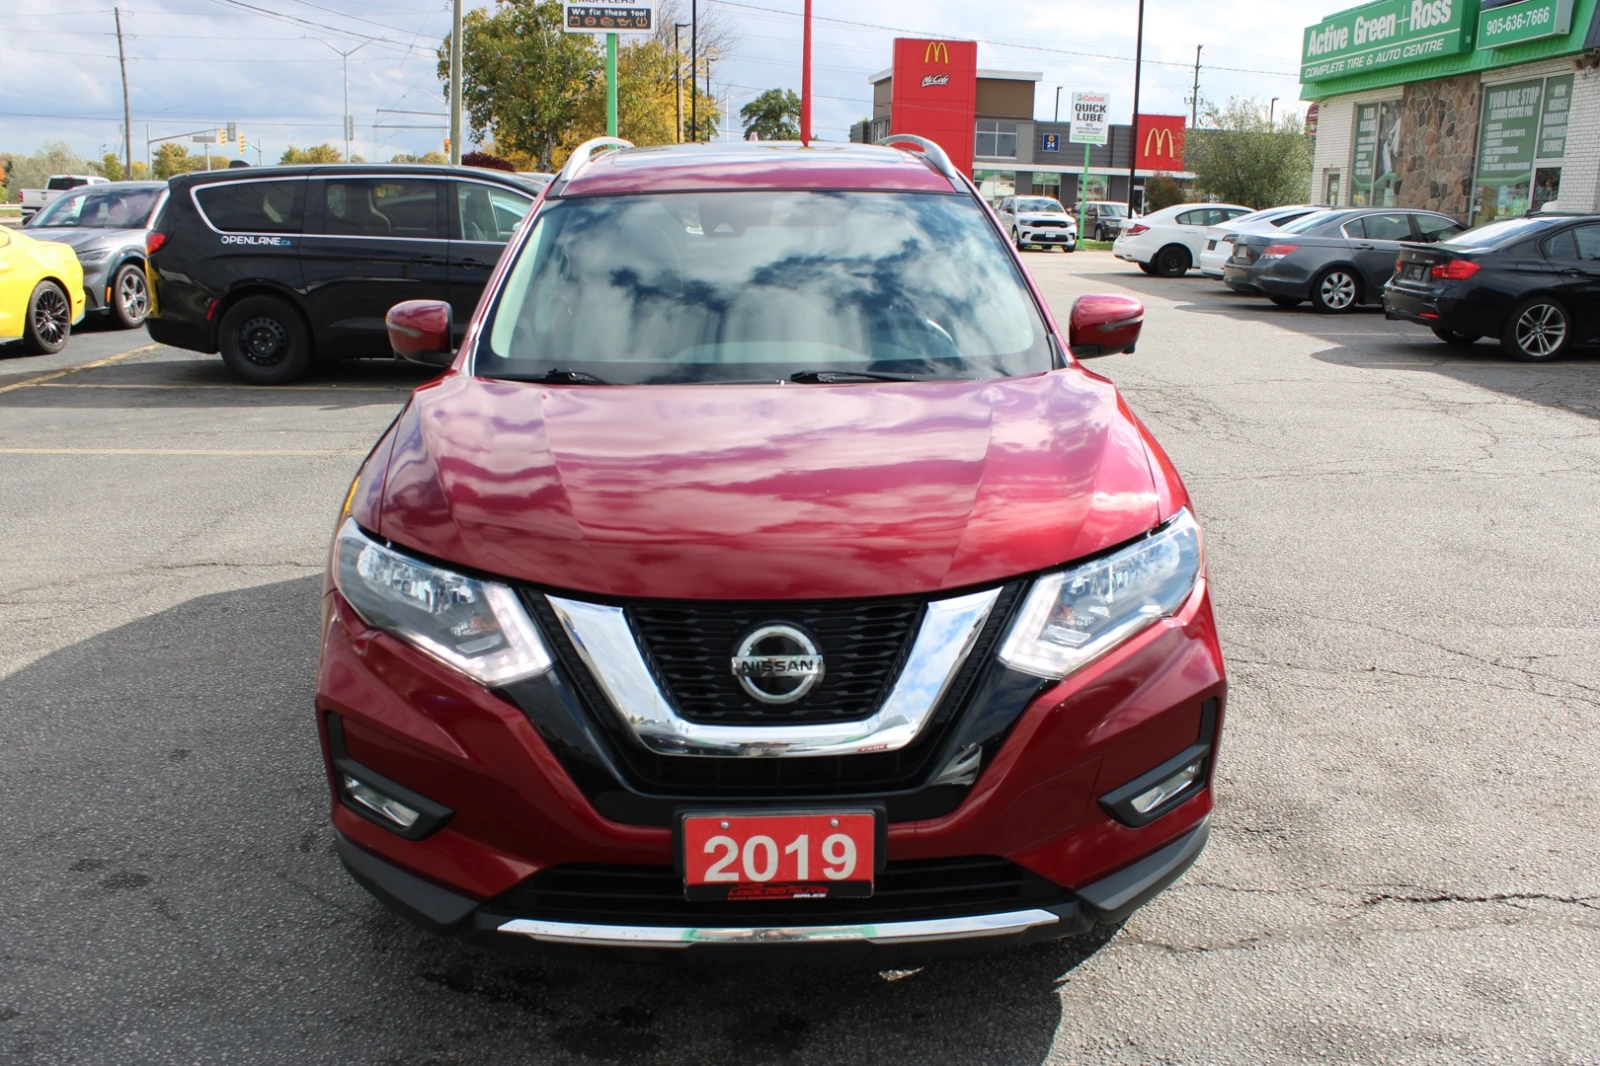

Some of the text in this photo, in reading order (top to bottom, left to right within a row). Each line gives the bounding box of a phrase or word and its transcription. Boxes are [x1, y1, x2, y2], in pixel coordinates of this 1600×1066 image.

[571, 8, 586, 16] We
[588, 8, 602, 16] fix
[604, 9, 628, 17] these
[1486, 6, 1551, 36] 905-636-7666
[1307, 24, 1349, 57] Active
[1353, 12, 1397, 46] Green
[1409, 0, 1453, 32] Ross
[1305, 38, 1445, 79] COMPLETE TIRE & AUTO CENTRE
[1507, 89, 1521, 107] ONE
[1521, 86, 1540, 105] STOP
[1075, 103, 1107, 113] QUICK
[1077, 113, 1104, 122] LUBE
[741, 660, 814, 672] NISSAN
[702, 833, 857, 882] 2019
